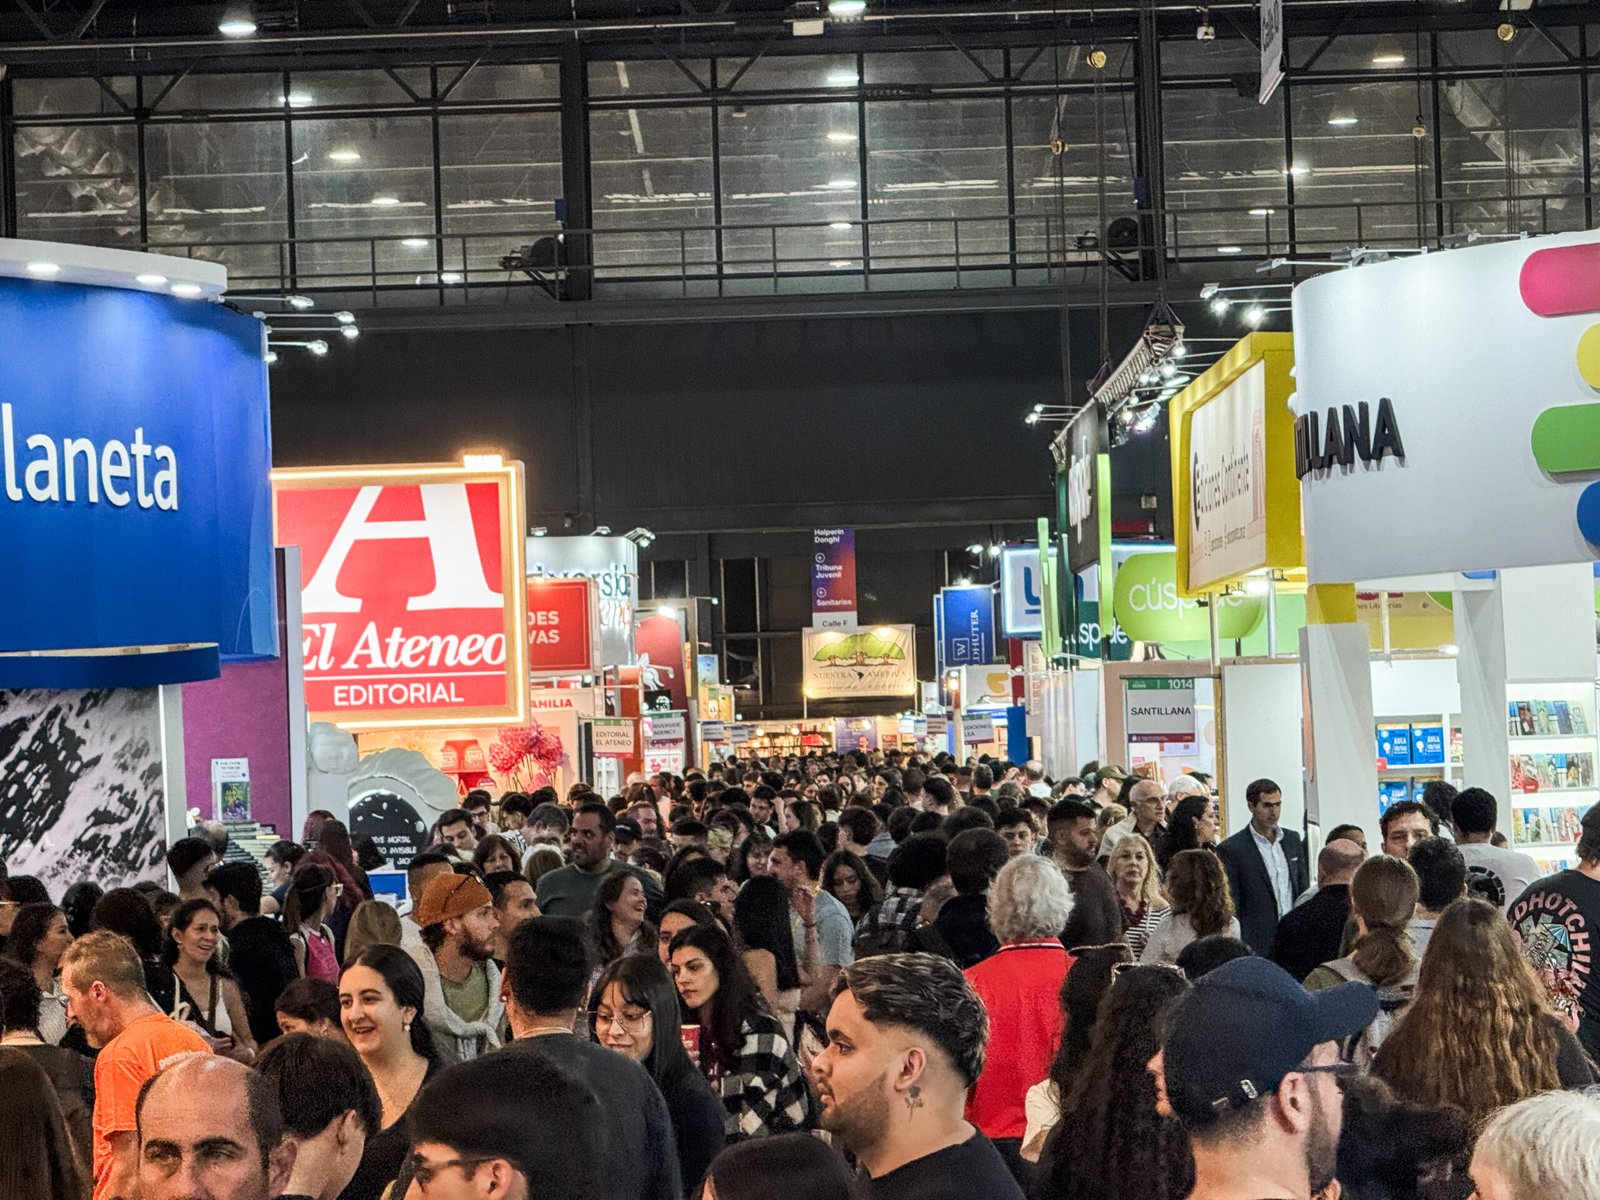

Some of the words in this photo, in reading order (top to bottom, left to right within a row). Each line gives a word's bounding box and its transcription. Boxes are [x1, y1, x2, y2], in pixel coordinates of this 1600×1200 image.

[2, 403, 178, 510] laneta
[814, 536, 840, 544] Donghi
[815, 571, 842, 579] Juvenil
[816, 599, 852, 607] Sanitarios
[302, 622, 337, 671] El
[341, 620, 507, 669] Ateneo
[813, 671, 853, 679] NUESTRA
[1168, 679, 1193, 689] 1014
[333, 682, 465, 706] EDITORIAL
[1130, 706, 1191, 716] SANTILLANA
